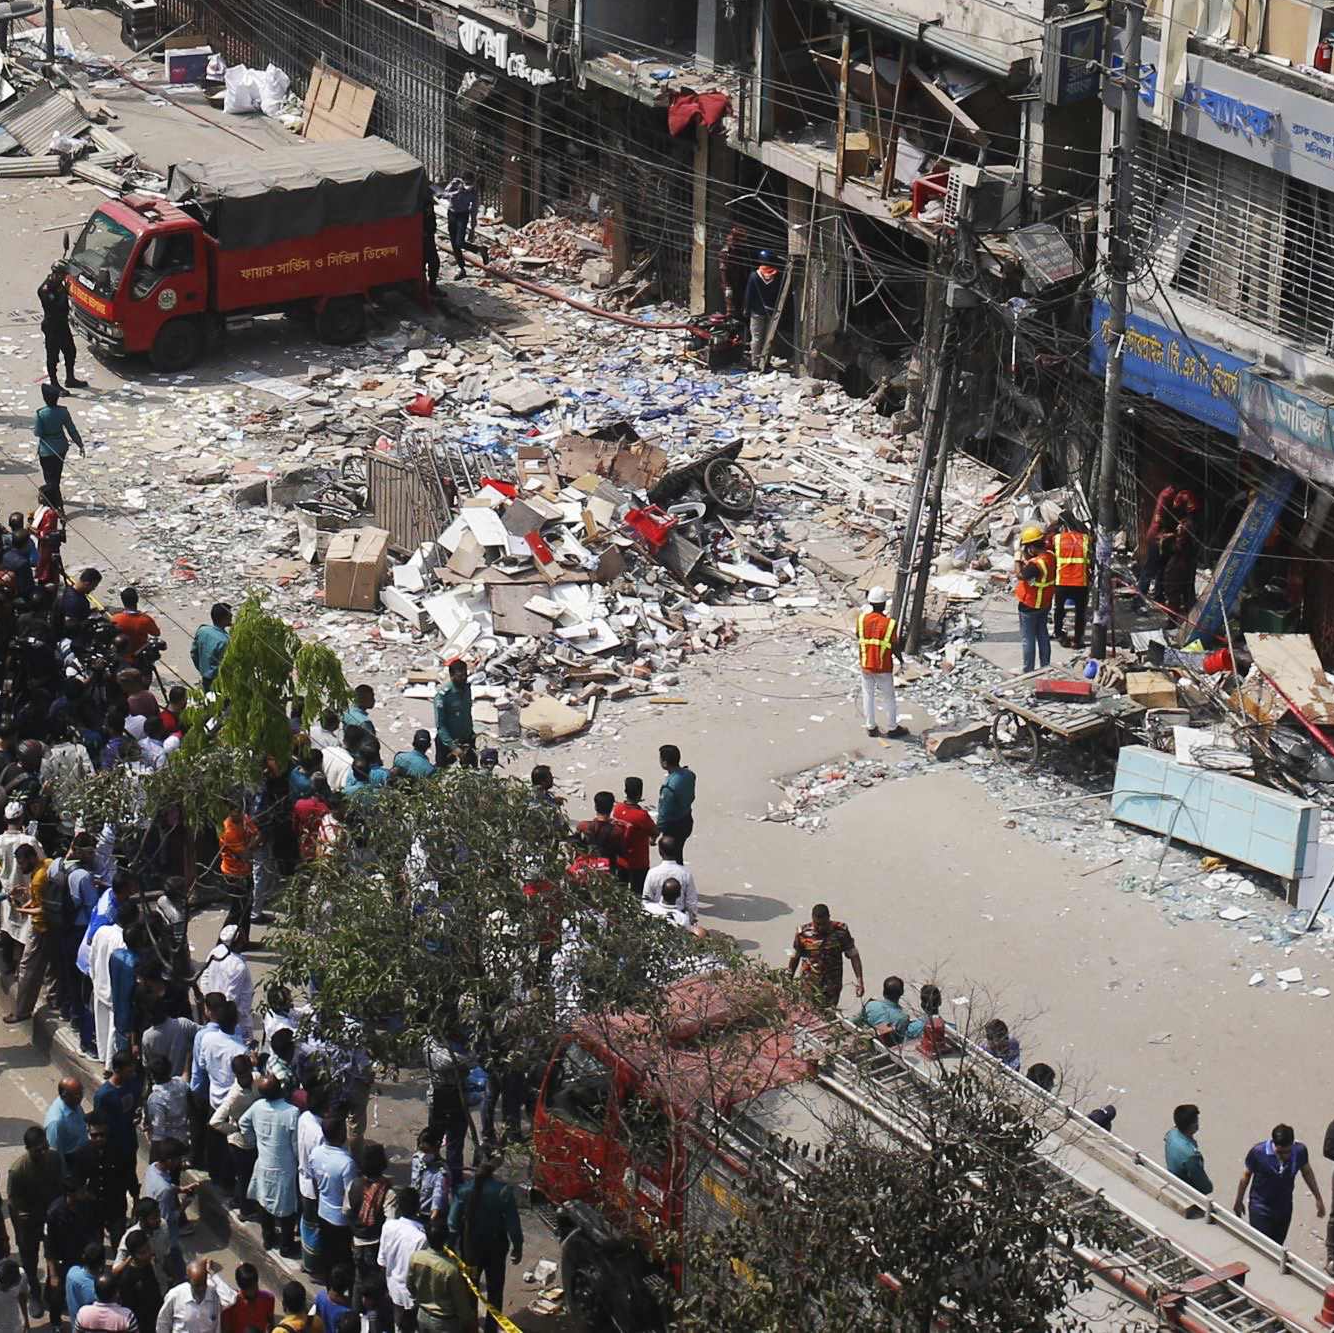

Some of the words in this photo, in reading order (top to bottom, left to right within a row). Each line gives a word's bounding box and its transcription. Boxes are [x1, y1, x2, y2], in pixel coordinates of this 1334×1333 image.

[240, 266, 275, 280] ফায়ার
[277, 258, 310, 275] সার্ভিস
[314, 258, 323, 268] ও
[327, 250, 360, 266] সিভিল
